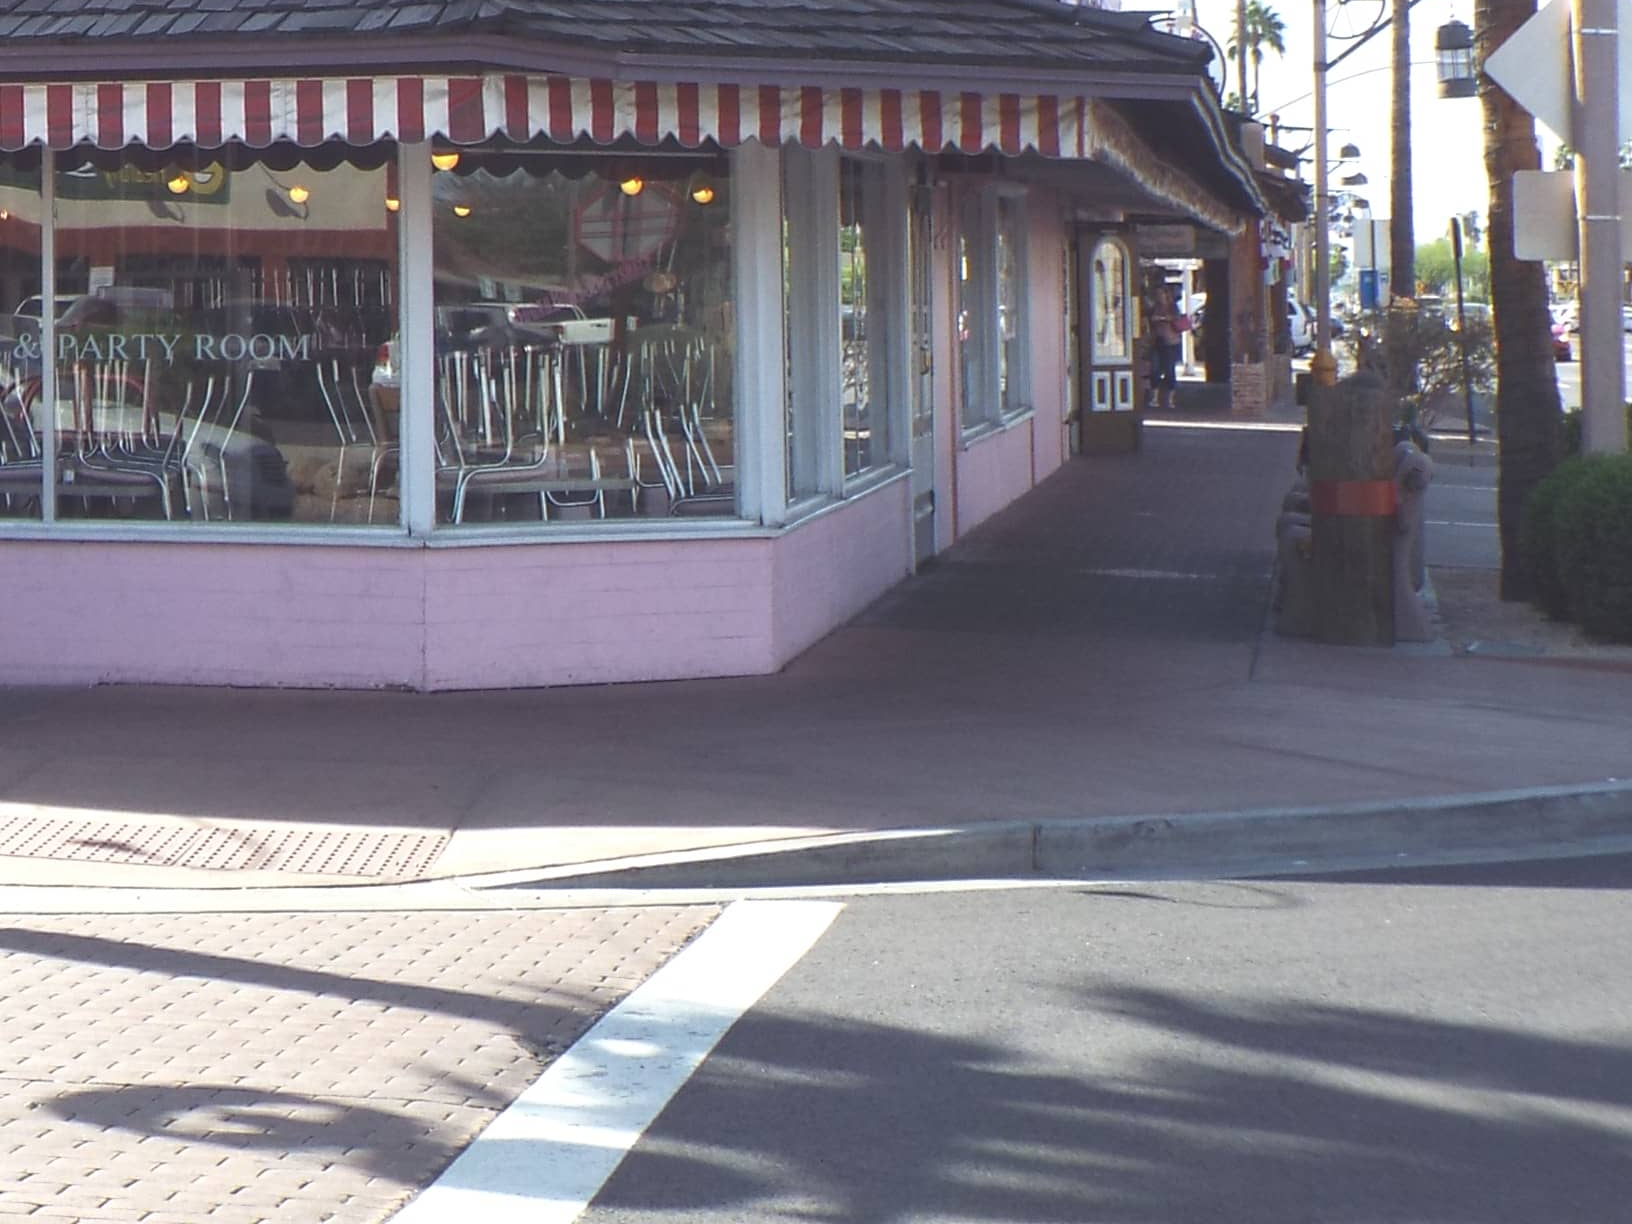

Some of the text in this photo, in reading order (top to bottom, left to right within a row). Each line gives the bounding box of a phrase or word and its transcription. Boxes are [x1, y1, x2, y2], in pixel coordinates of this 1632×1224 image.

[13, 332, 42, 360] &
[58, 333, 181, 362] PARTY
[195, 332, 311, 362] ROOM
